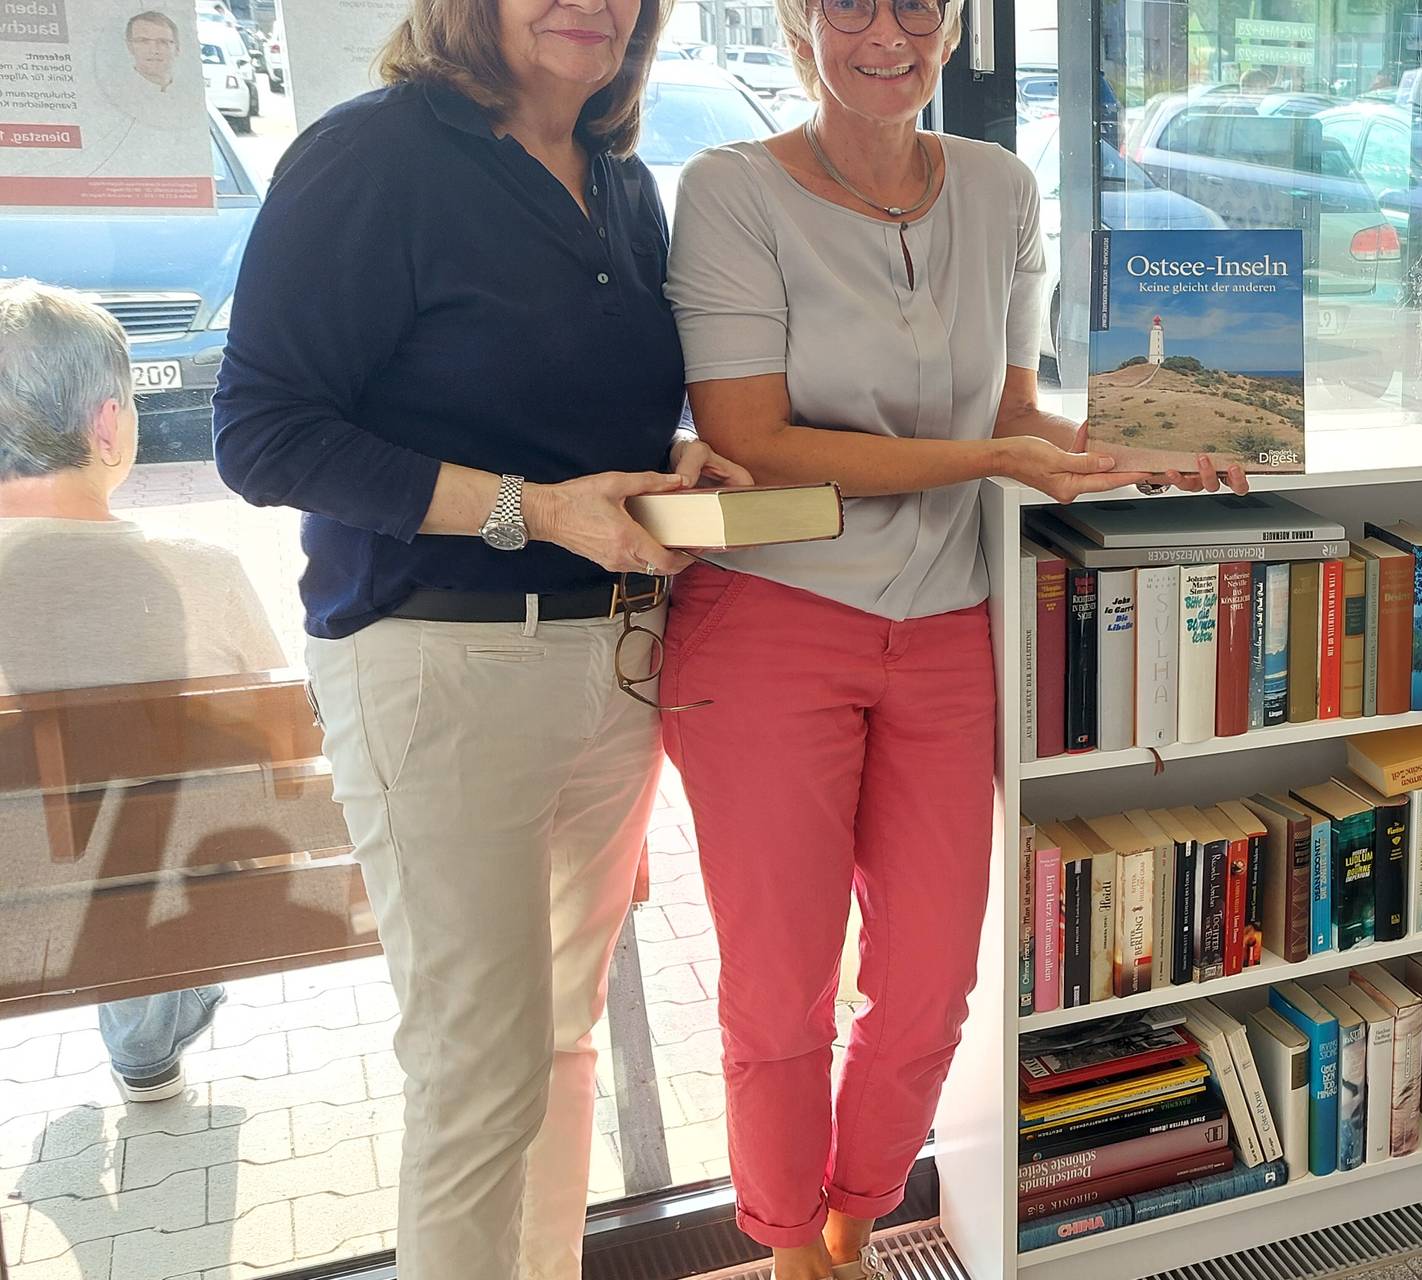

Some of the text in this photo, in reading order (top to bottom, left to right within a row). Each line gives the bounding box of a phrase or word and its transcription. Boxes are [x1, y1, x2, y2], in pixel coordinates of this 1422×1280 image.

[1127, 255, 1288, 277] Ostsee-Inseln
[1139, 282, 1276, 294] Keine gleicht der anderen
[1259, 452, 1298, 466] Digest
[1148, 547, 1265, 562] RICHARD VON WEIZSÄCKER
[1186, 574, 1217, 583] Johannes
[1192, 581, 1213, 589] Mario
[1189, 587, 1214, 595] Simmel
[1344, 851, 1373, 867] LUDLUM
[1046, 875, 1055, 892] Ein
[1099, 880, 1112, 911] Heidi
[1046, 894, 1054, 917] Herz
[1046, 919, 1054, 933] für
[1135, 915, 1144, 956] BERLING
[1044, 959, 1052, 982] allein
[1050, 1150, 1097, 1171] schönste
[1019, 1165, 1092, 1192] Deutschlands
[1050, 1191, 1098, 1209] CHRONIK
[1057, 1215, 1105, 1238] CHINA
